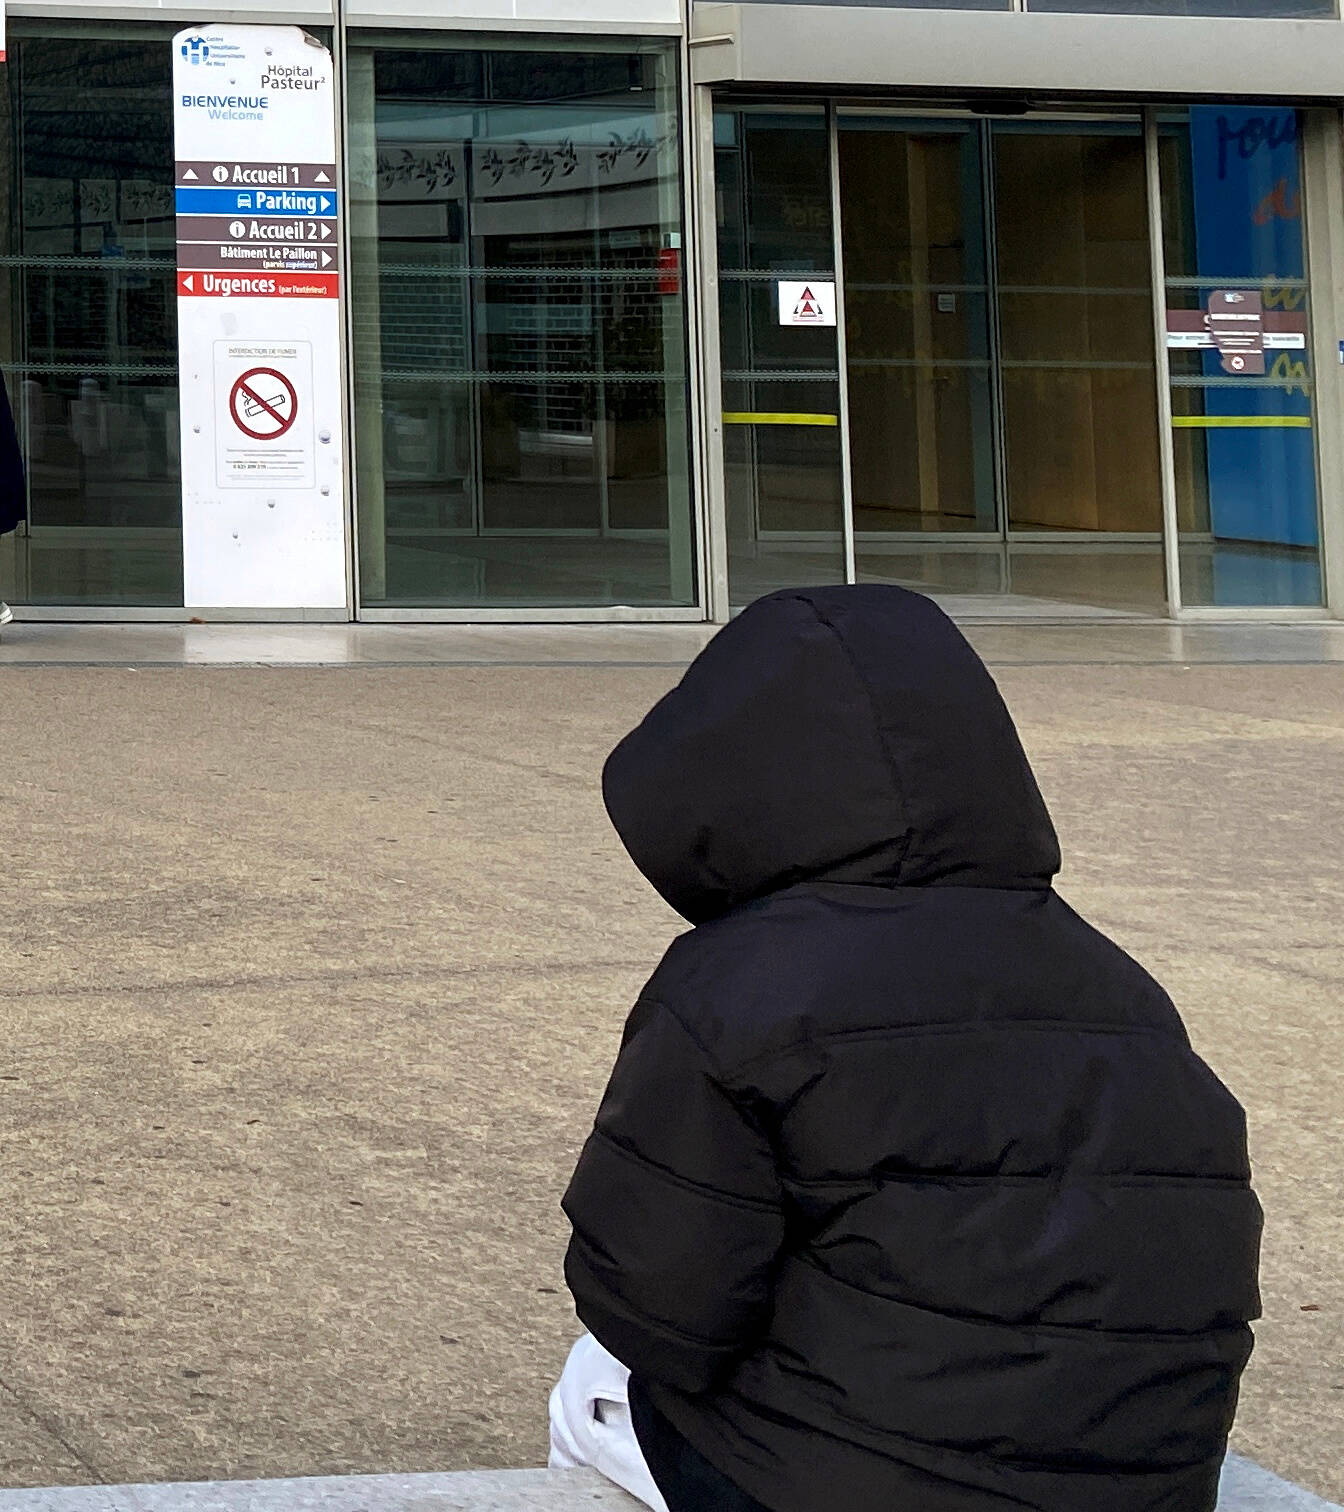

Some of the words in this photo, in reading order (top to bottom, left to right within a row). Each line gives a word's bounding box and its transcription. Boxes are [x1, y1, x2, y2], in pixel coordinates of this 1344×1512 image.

[268, 65, 313, 78] Hôpital
[182, 95, 268, 108] BIENVENUE
[208, 109, 264, 120] Welcome
[232, 165, 287, 184] Accueil
[291, 167, 299, 184] 1
[256, 191, 317, 215] Parking
[249, 220, 304, 239] Accueil
[307, 222, 317, 240] 2
[220, 246, 267, 259] Bâtiment
[270, 247, 281, 259] Le
[283, 248, 317, 260] Paillon
[203, 274, 275, 297] Urgences
